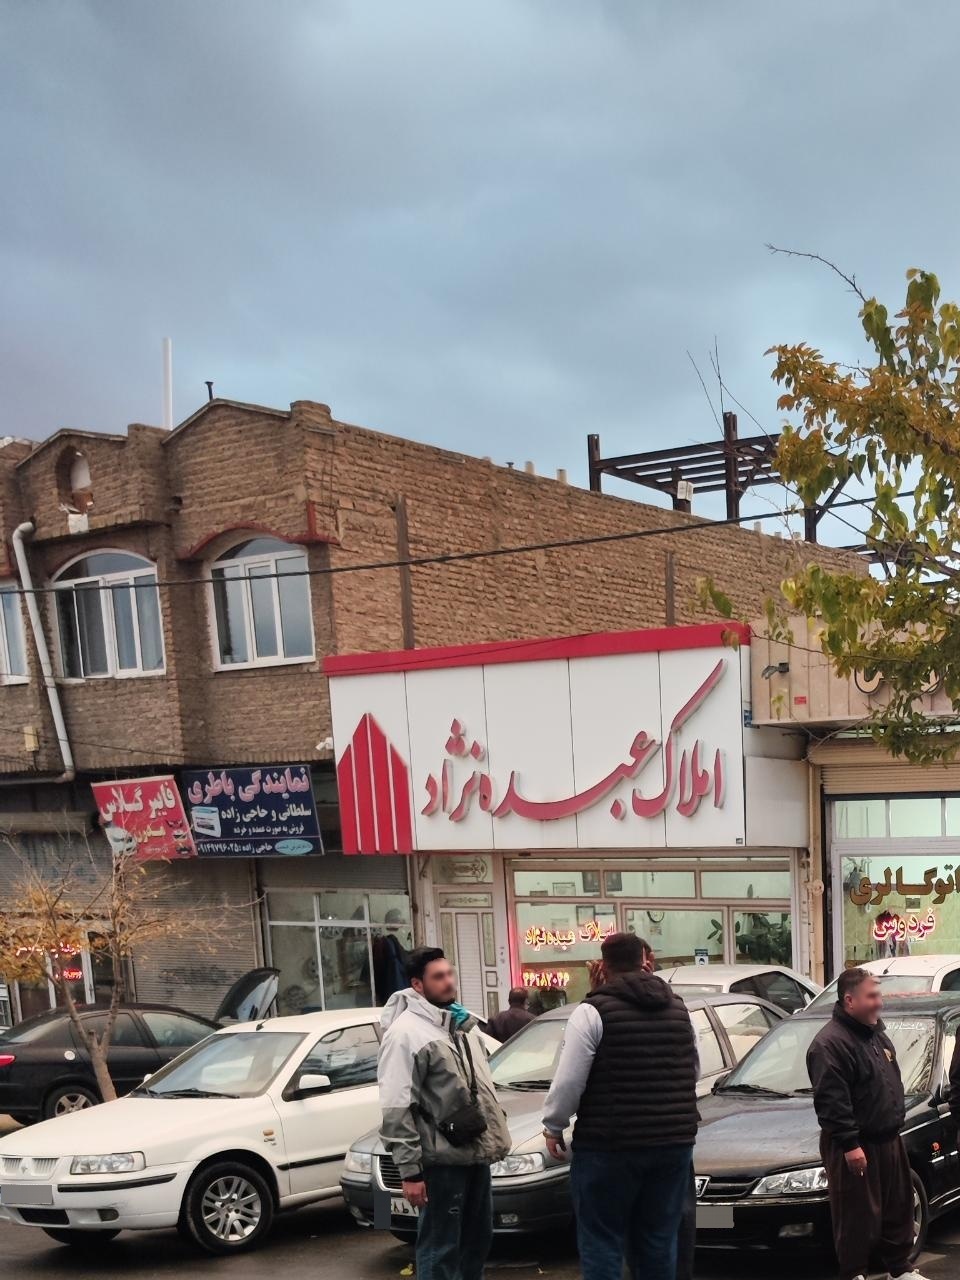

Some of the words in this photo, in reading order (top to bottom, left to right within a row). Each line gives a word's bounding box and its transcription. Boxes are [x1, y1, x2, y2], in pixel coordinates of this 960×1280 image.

[633, 657, 726, 819] املاک
[149, 781, 176, 819] فایبر
[187, 770, 235, 804] باطری
[238, 767, 310, 802] نمایندگی
[101, 785, 144, 822] گلاس
[221, 806, 241, 823] زاده
[242, 805, 268, 823] حاجی
[278, 803, 312, 821] سلطانی
[289, 822, 305, 835] فروش
[255, 842, 273, 854] حاجی
[873, 908, 936, 941] فردوس
